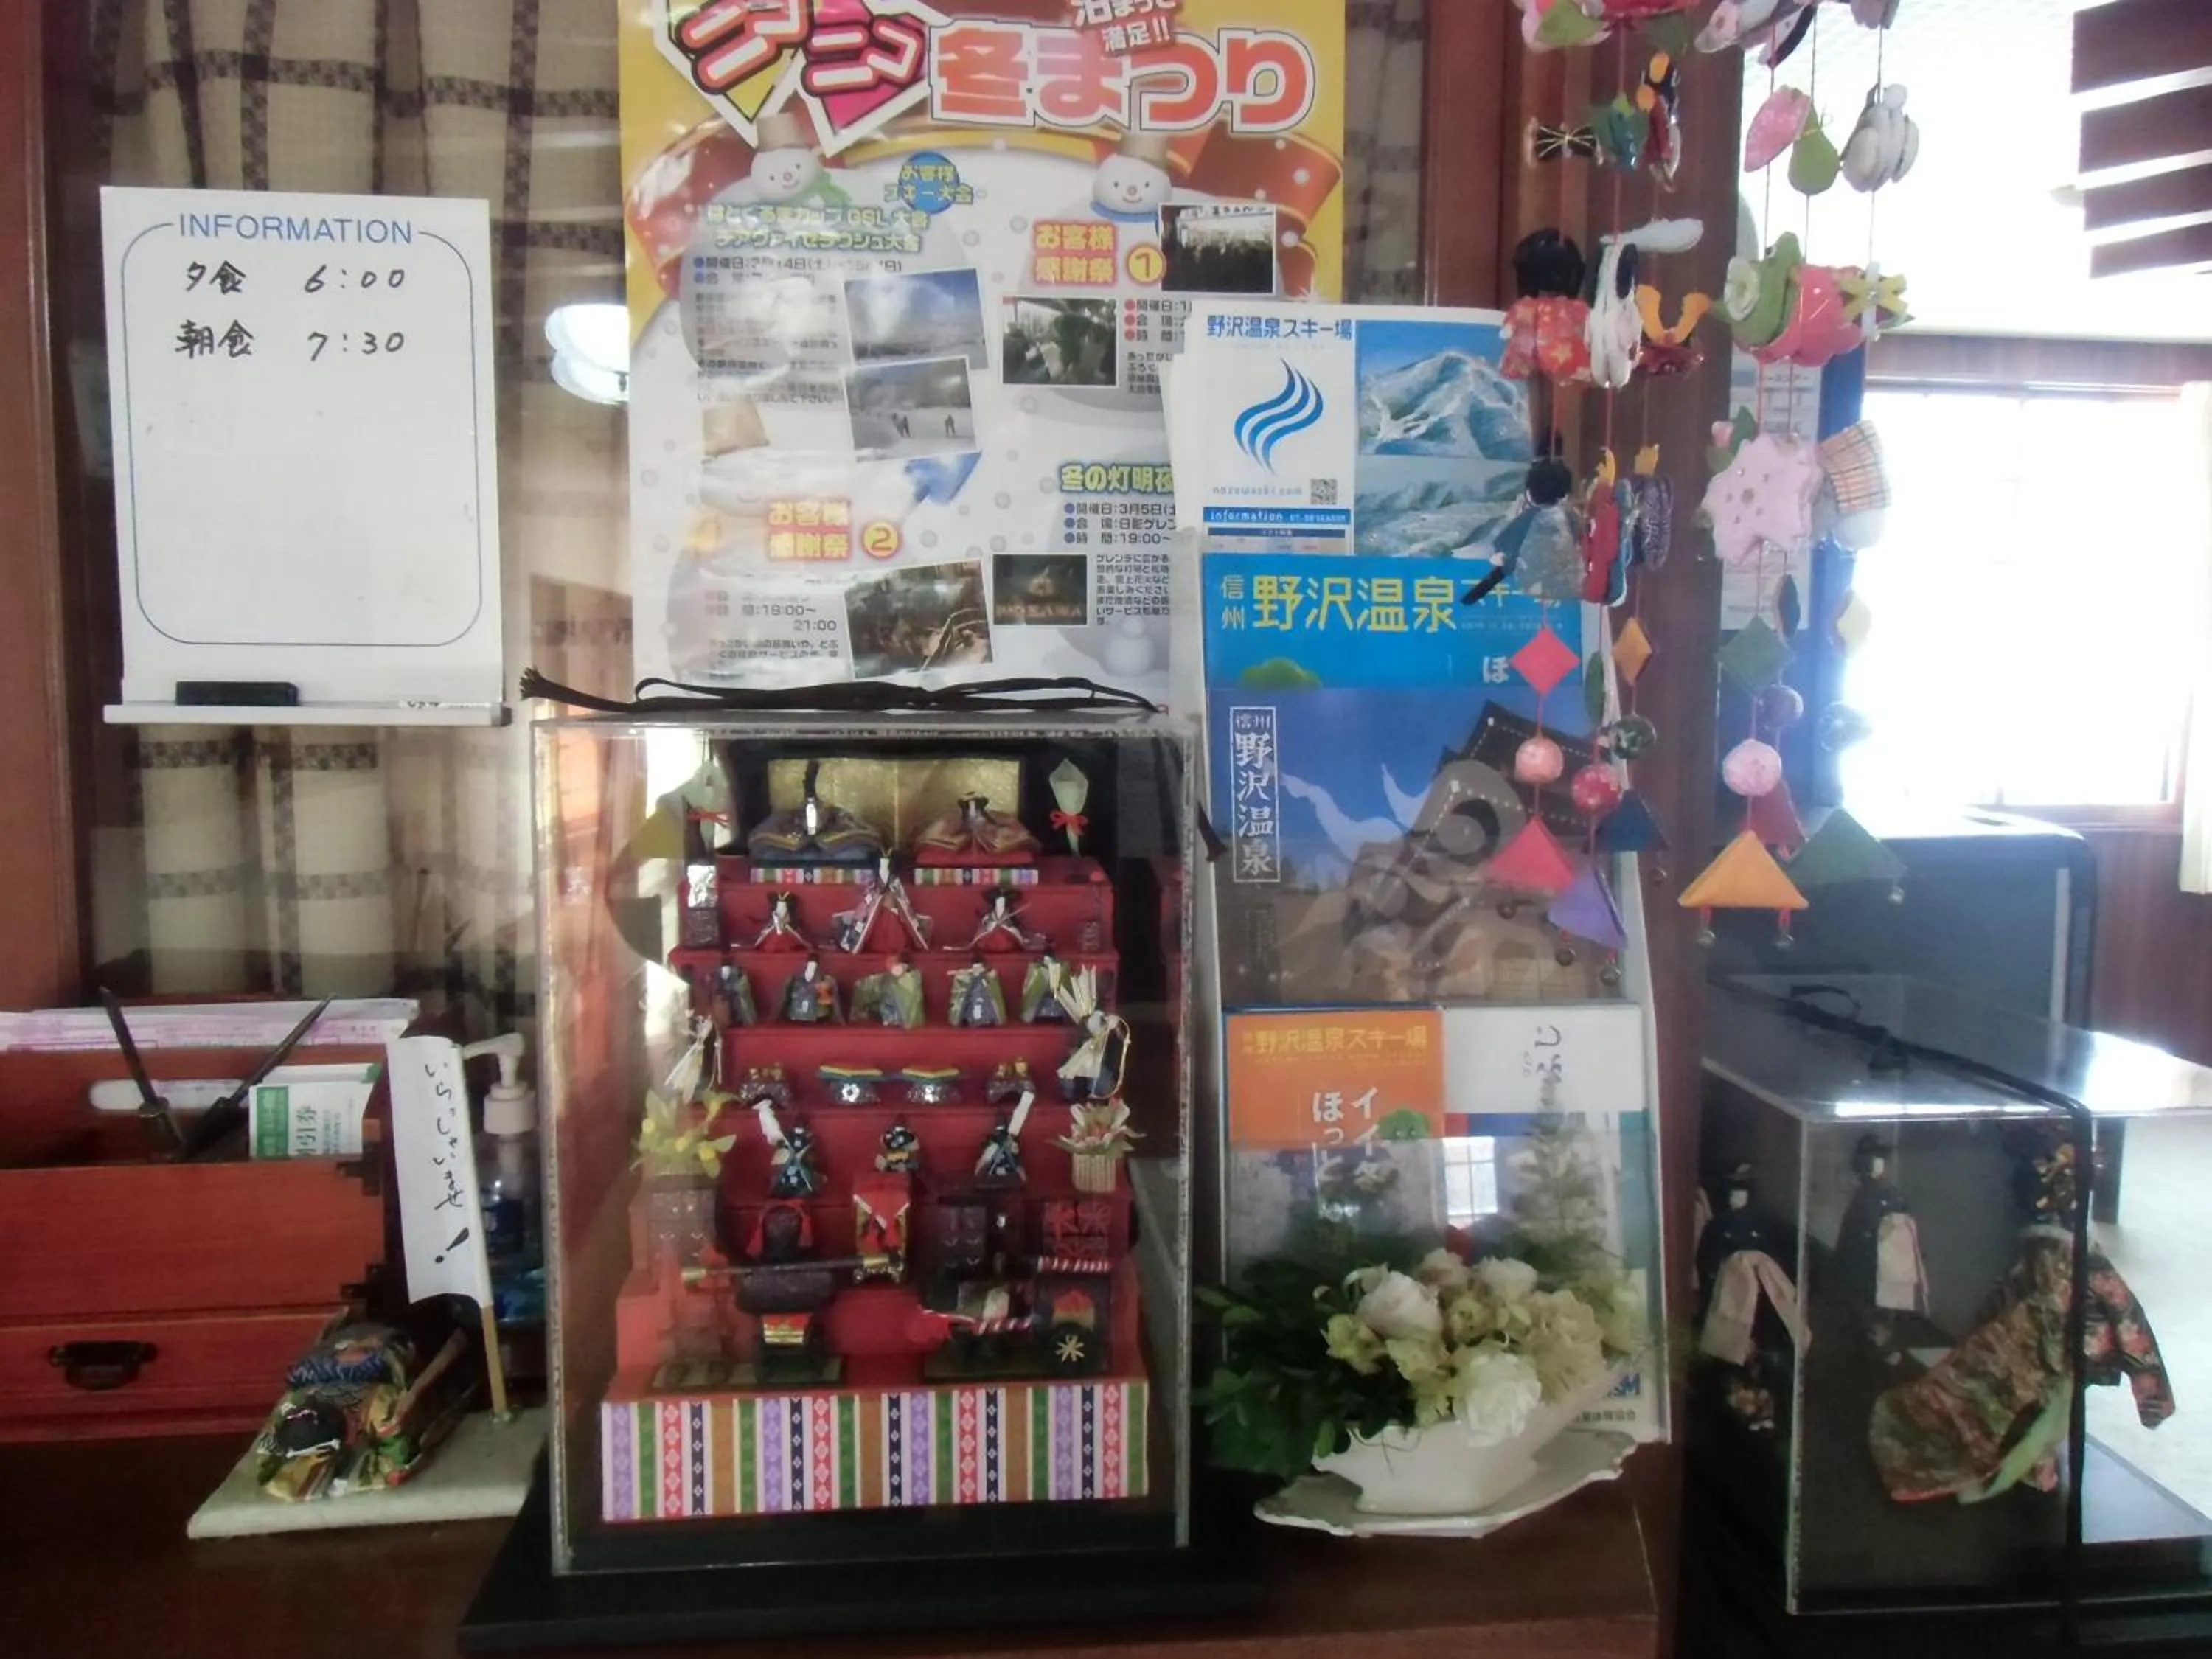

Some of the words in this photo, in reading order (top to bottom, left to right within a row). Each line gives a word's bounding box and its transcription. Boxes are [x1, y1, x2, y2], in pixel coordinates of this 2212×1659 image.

[933, 25, 1312, 128] 冬まつり
[180, 212, 411, 244] INFORMATION
[1035, 223, 1115, 250] お客様
[186, 260, 246, 295] 夕食
[304, 264, 405, 293] 6:00
[1035, 256, 1115, 284] 感謝祭
[175, 319, 254, 359] 朝食
[307, 331, 405, 361] 7:30
[1207, 315, 1353, 340] 野沢温泉スキー場
[769, 501, 849, 526] お客様
[1221, 574, 1245, 631] 信州
[1252, 574, 1457, 633] 野沢温泉
[1234, 731, 1275, 876] 野沢温泉
